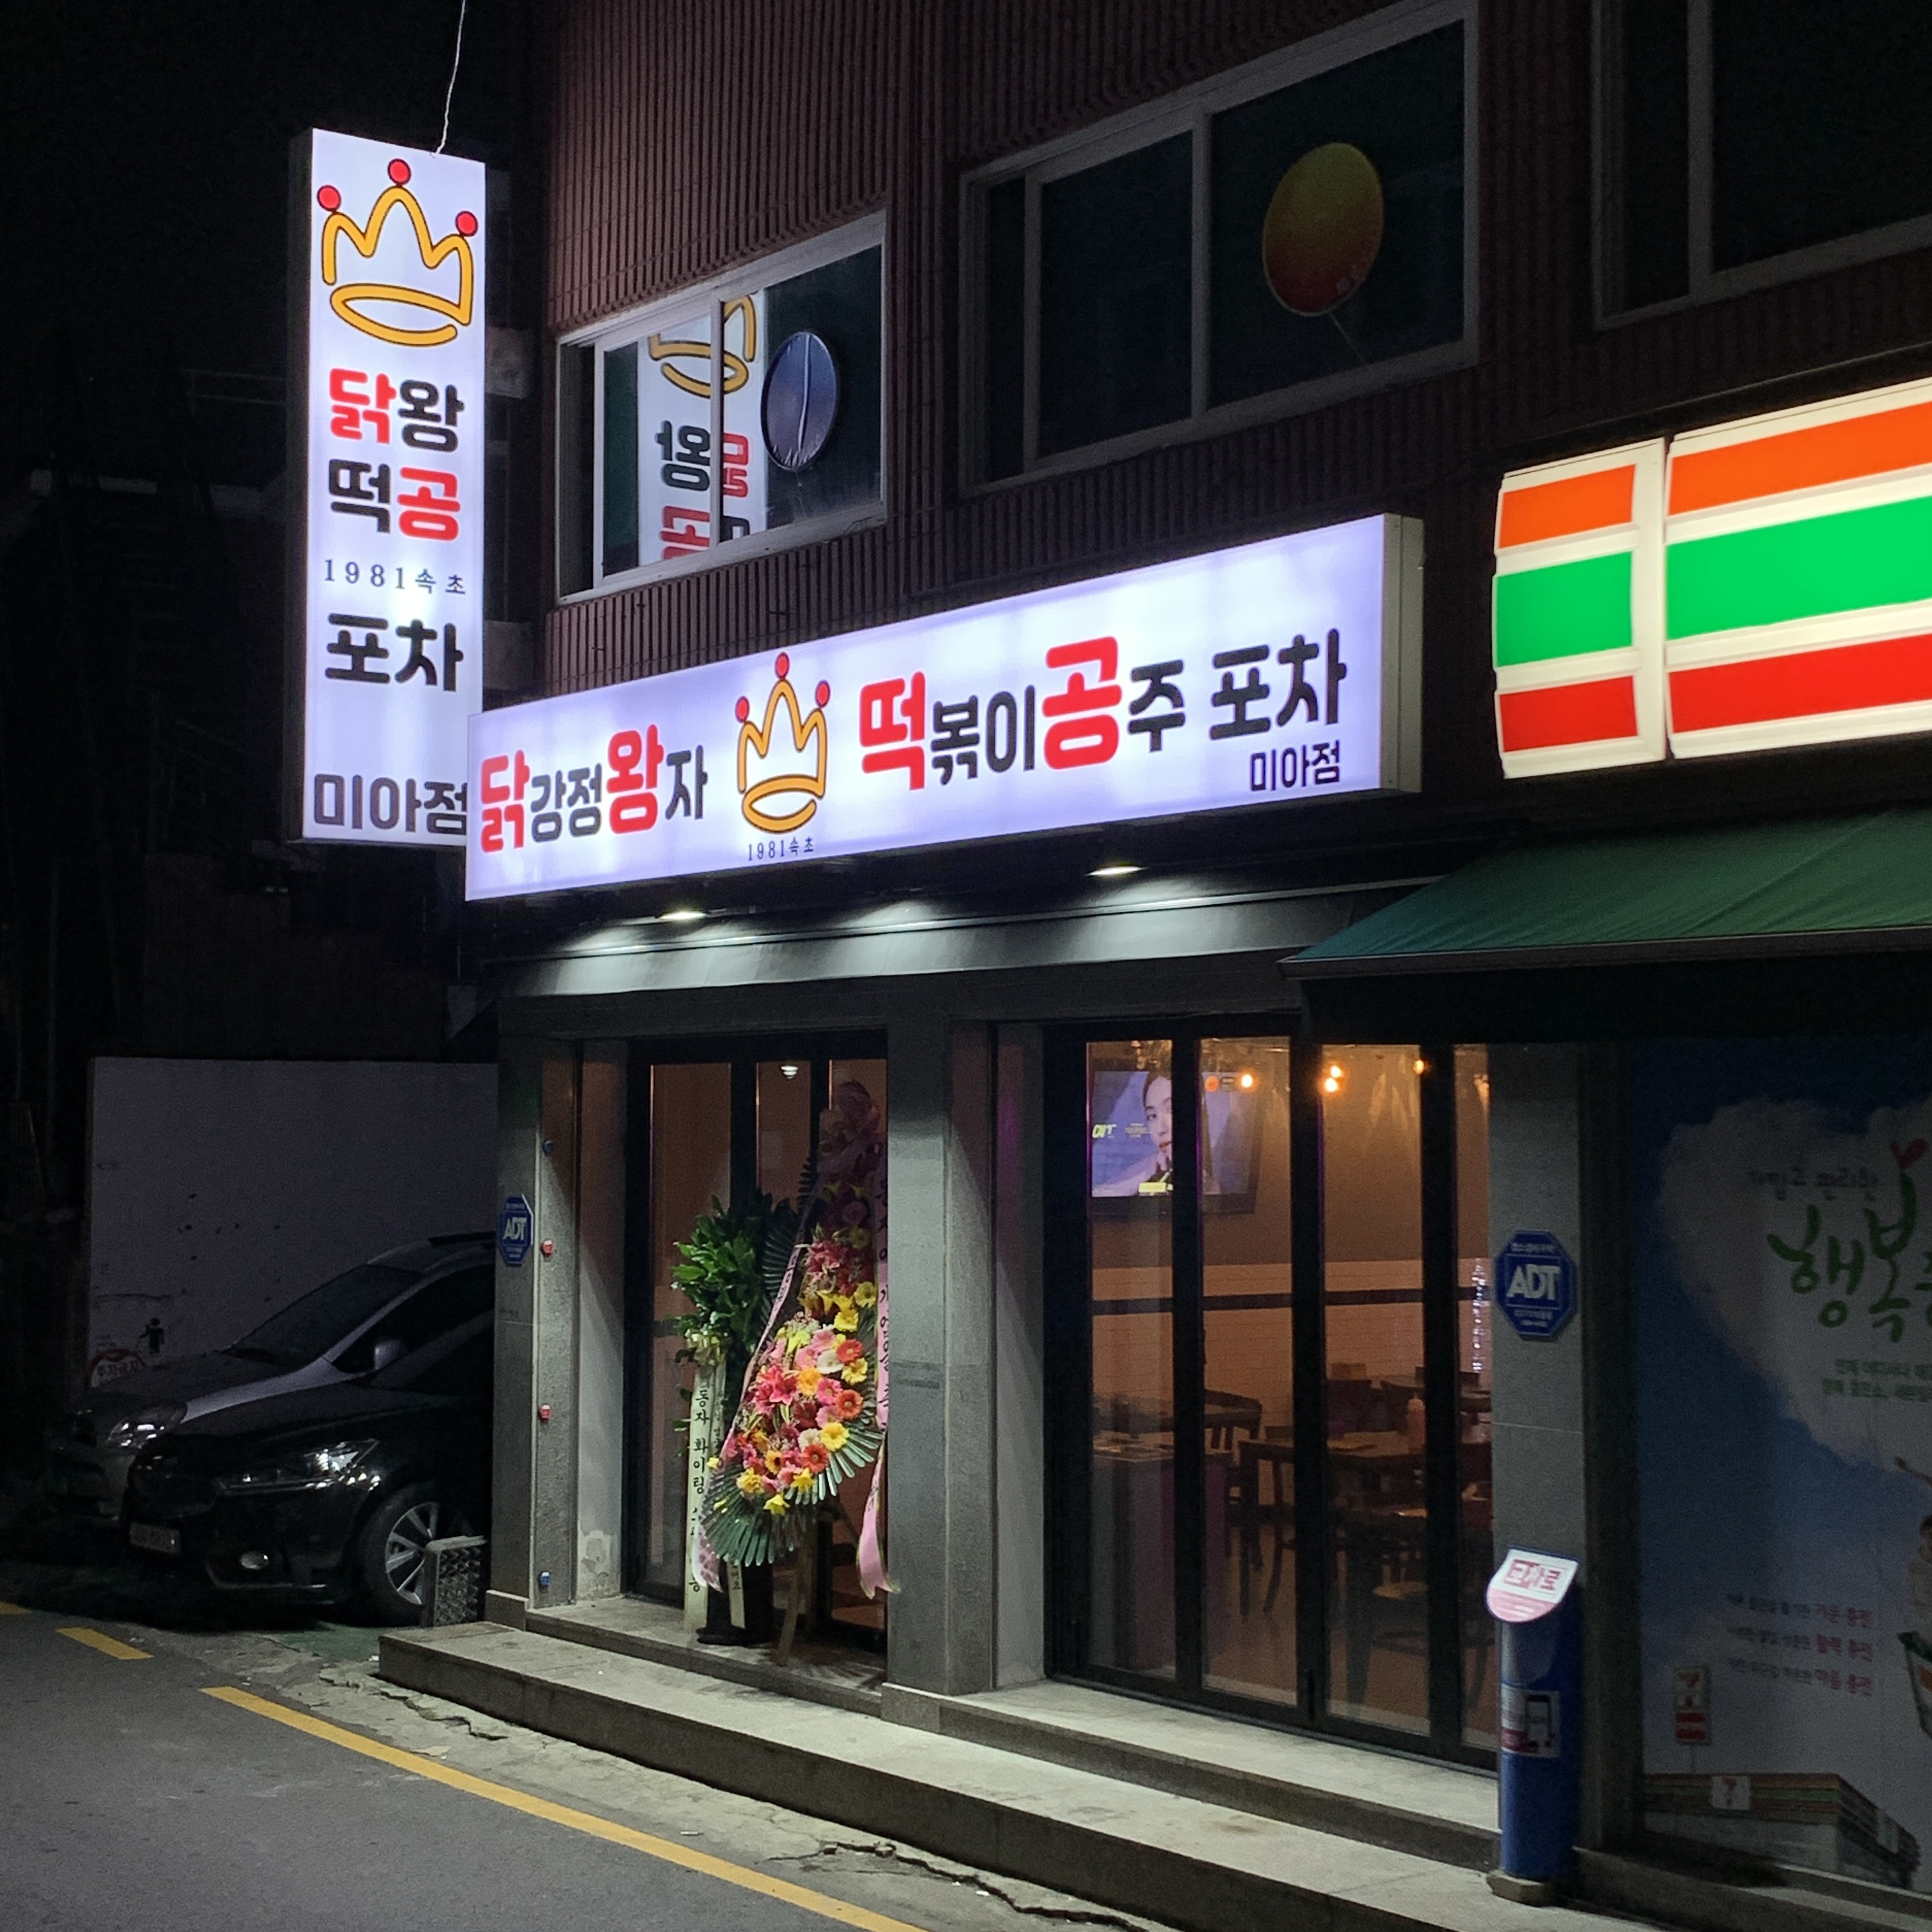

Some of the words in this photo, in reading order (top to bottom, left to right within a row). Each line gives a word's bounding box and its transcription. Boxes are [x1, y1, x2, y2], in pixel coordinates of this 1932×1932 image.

[330, 369, 464, 452] 닭왕
[328, 459, 461, 541] 떡공
[324, 558, 466, 595] 1981속초
[325, 613, 464, 693] 포차
[480, 724, 708, 853] 닭강정왕자
[859, 636, 1186, 791] 떡볶이공주
[1209, 628, 1347, 742] 포차
[1250, 740, 1341, 792] 미아점
[313, 774, 466, 834] 미아점
[747, 836, 815, 861] 1981속초
[502, 1216, 527, 1241] ADT
[1506, 1262, 1561, 1301] ADT
[693, 1437, 709, 1494] 화이팅
